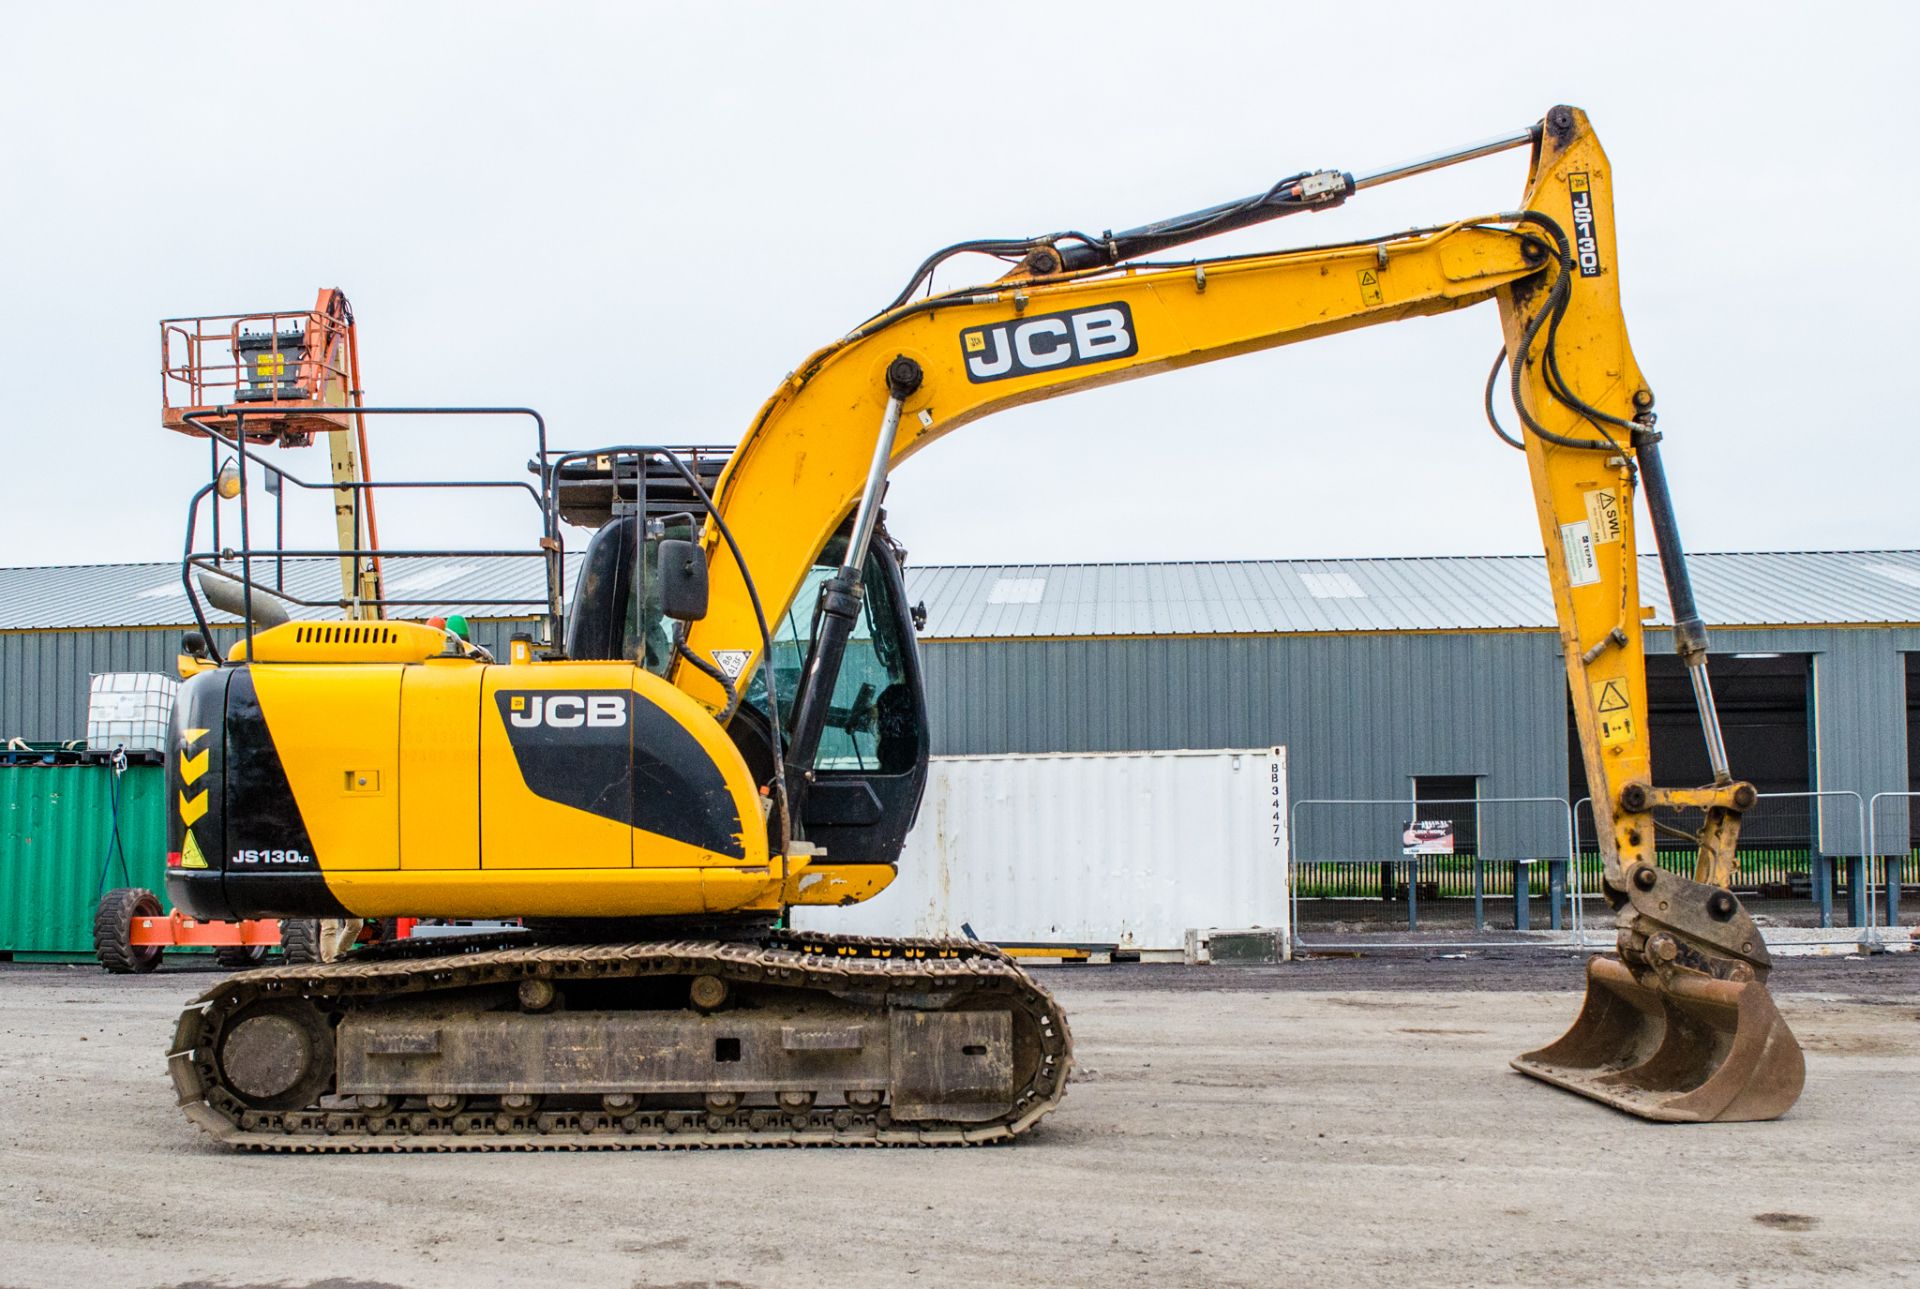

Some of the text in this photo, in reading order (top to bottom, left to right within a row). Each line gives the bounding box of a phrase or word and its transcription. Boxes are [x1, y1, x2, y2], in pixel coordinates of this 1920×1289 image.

[969, 308, 1130, 377] JCB
[1606, 509, 1620, 539] SWL
[510, 696, 626, 728] JCB
